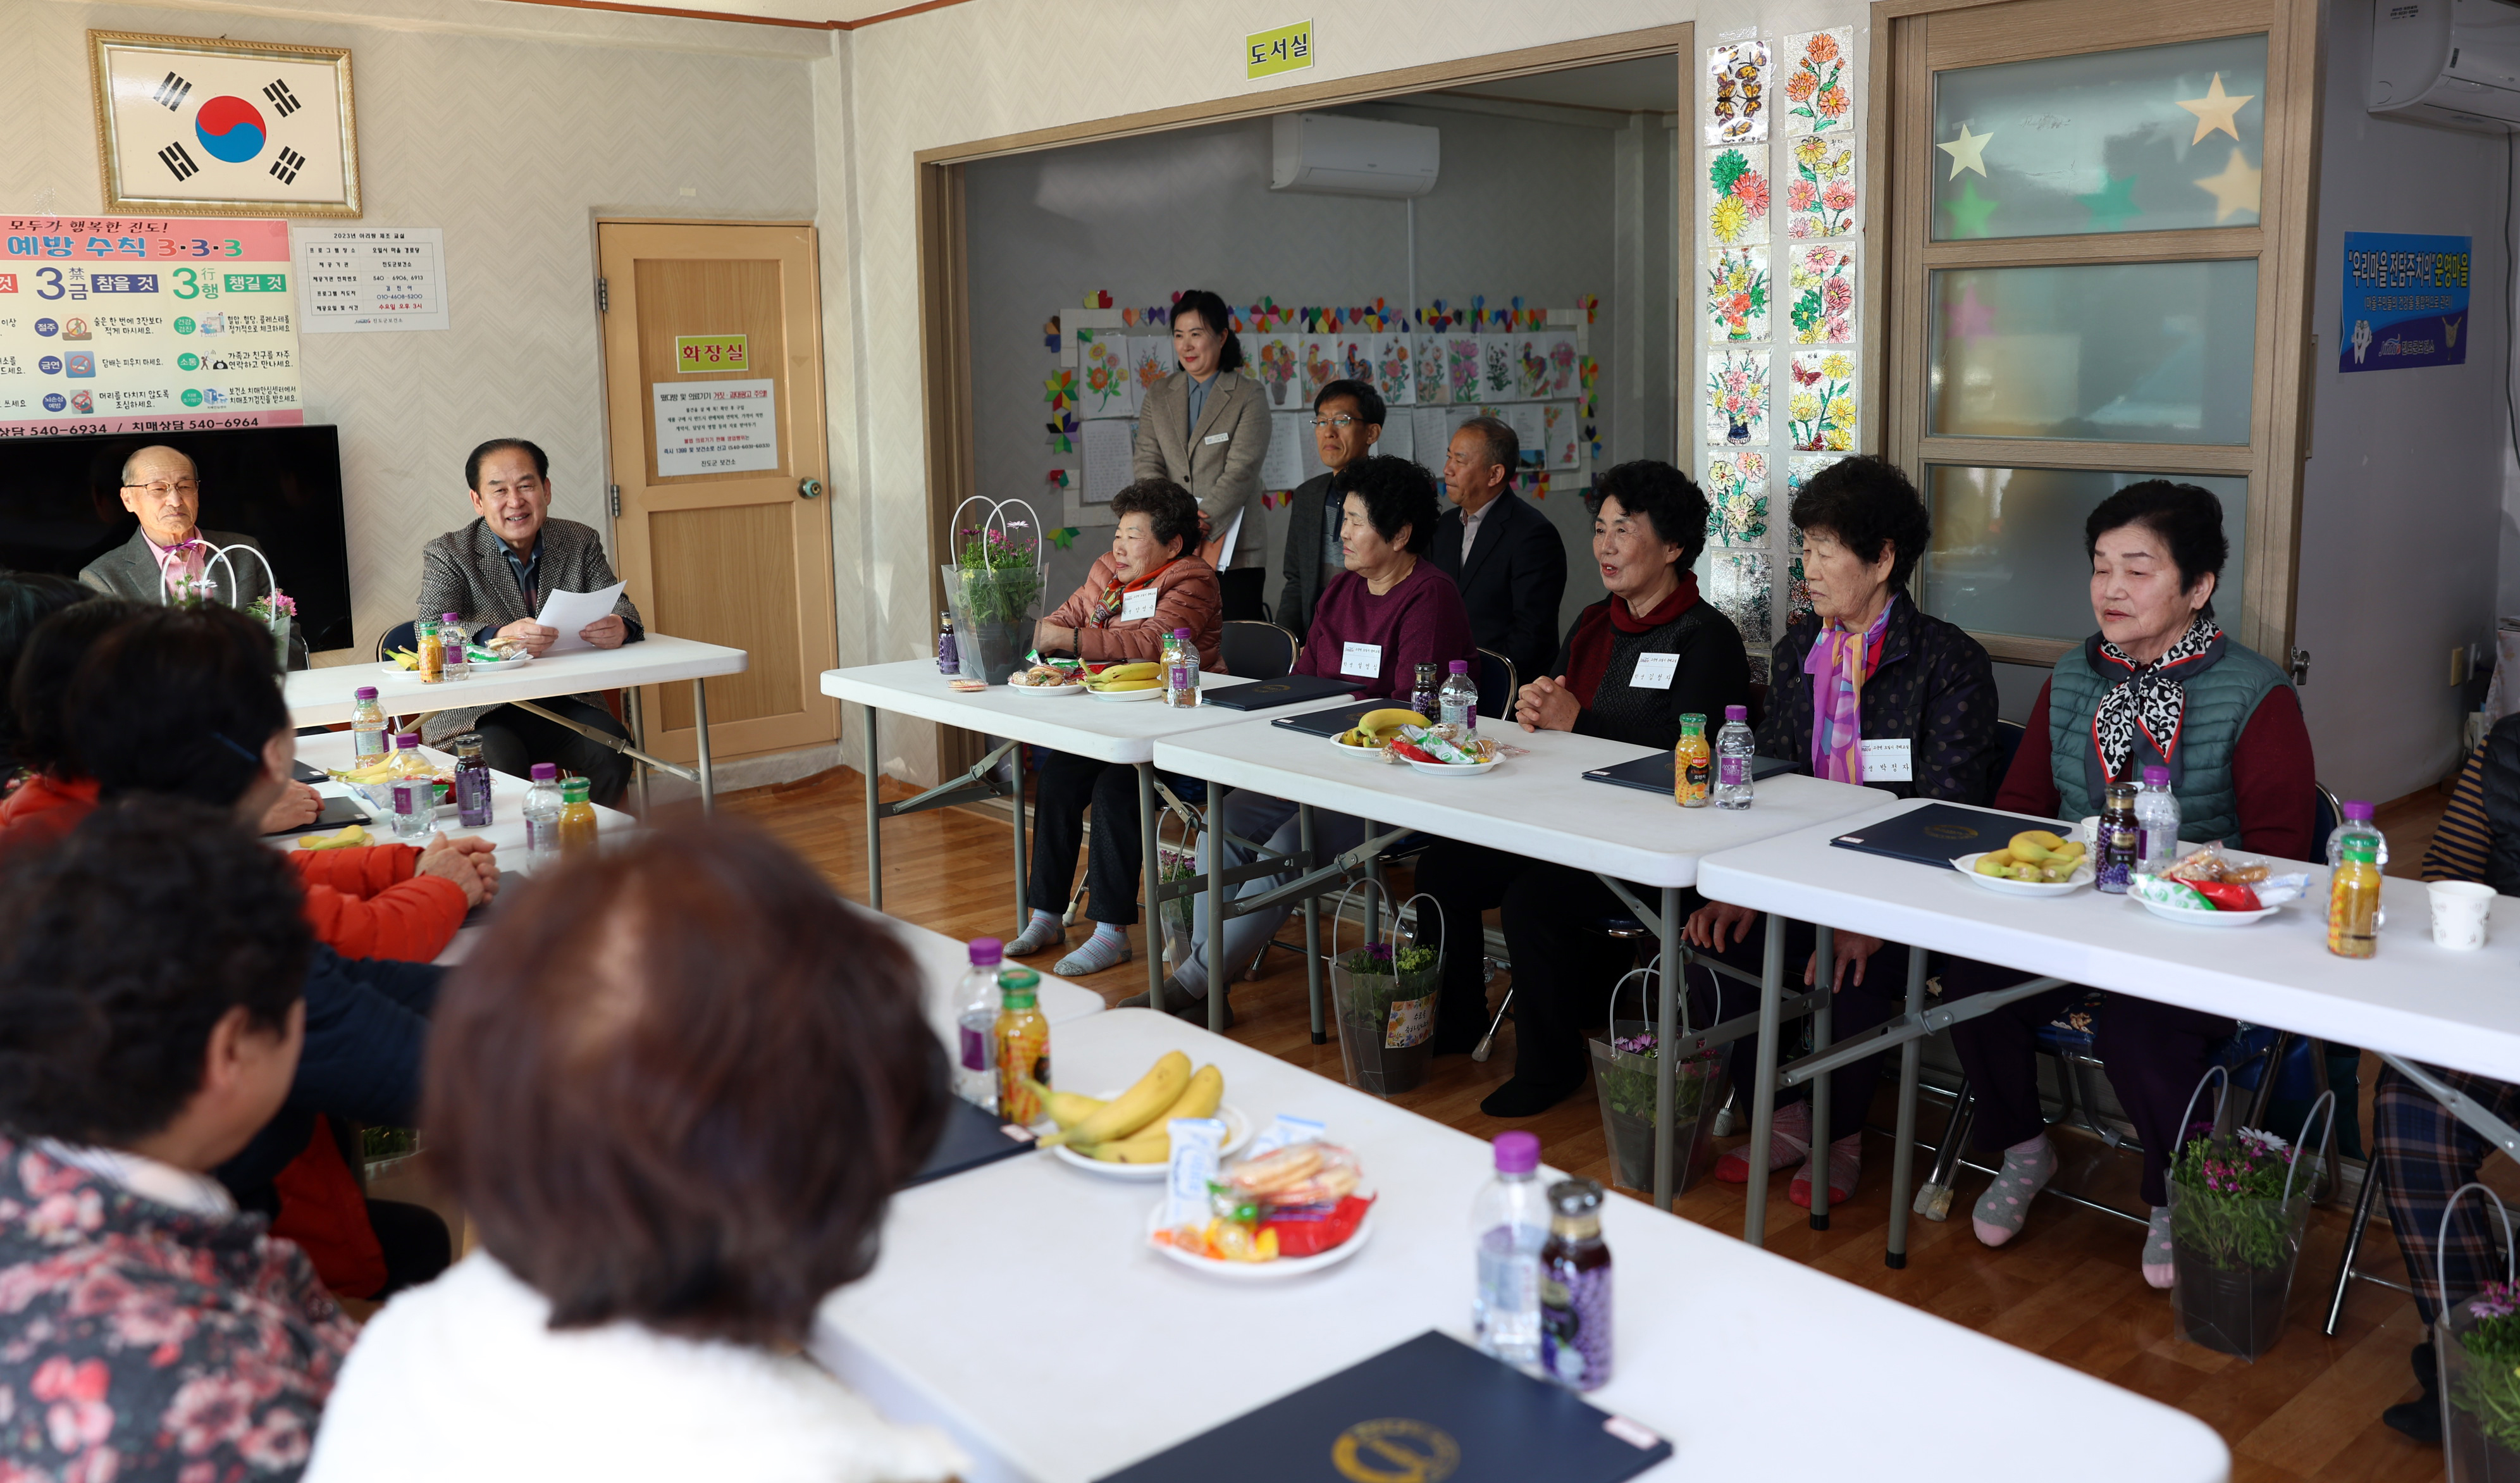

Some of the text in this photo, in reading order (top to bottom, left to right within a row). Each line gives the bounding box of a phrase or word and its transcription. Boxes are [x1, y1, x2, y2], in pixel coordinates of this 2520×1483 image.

[1251, 33, 1307, 65] 도서실
[8, 220, 168, 233] 모두가 행복한 진도!
[7, 235, 75, 258] 예방
[85, 236, 147, 258] 수칙
[68, 267, 85, 281] 禁
[201, 267, 216, 281] 行
[2435, 253, 2469, 289] 운영마을
[35, 266, 66, 301] 3
[96, 275, 154, 291] 참을 것
[172, 267, 200, 300] 3
[229, 275, 282, 291] 챙길 것
[68, 283, 89, 301] 금
[201, 283, 219, 300] 행
[2378, 295, 2397, 311] 주민들의
[2399, 295, 2413, 311] 건강을
[1, 318, 16, 328] 이상
[94, 316, 163, 327] 술은 한 번에 3잔보다
[227, 316, 242, 324] 혈압,
[260, 314, 290, 324] 콜레스테롤
[37, 323, 56, 332] 절주
[104, 326, 154, 336] 적게 마시세요.
[228, 324, 290, 334] 정기적으로 체크하세요
[228, 350, 290, 361] 가족과 친구를 자주
[682, 344, 744, 363] 화장실
[41, 361, 60, 370] 금연
[102, 358, 163, 369] 담배는 피우지 마세요.
[180, 357, 197, 366] 소통
[228, 359, 293, 370] 연락하고 만나세요.
[99, 390, 170, 401] 머리를 다치지 않도록
[229, 386, 296, 396] 보건소 치매안심센터에서
[660, 393, 678, 402] 떴다방
[688, 392, 711, 400] 의료기기
[713, 391, 725, 399] 거짓
[730, 390, 751, 399] 과대광고
[4, 399, 27, 409] 쓰세요
[116, 399, 155, 409] 조심하세요.
[230, 395, 298, 405] 치매조기검진을 받으세요.
[30, 424, 108, 435] 540-6934
[132, 419, 184, 433] 치매상담
[189, 418, 259, 429] 540-6964
[1880, 763, 1909, 772] 박정자
